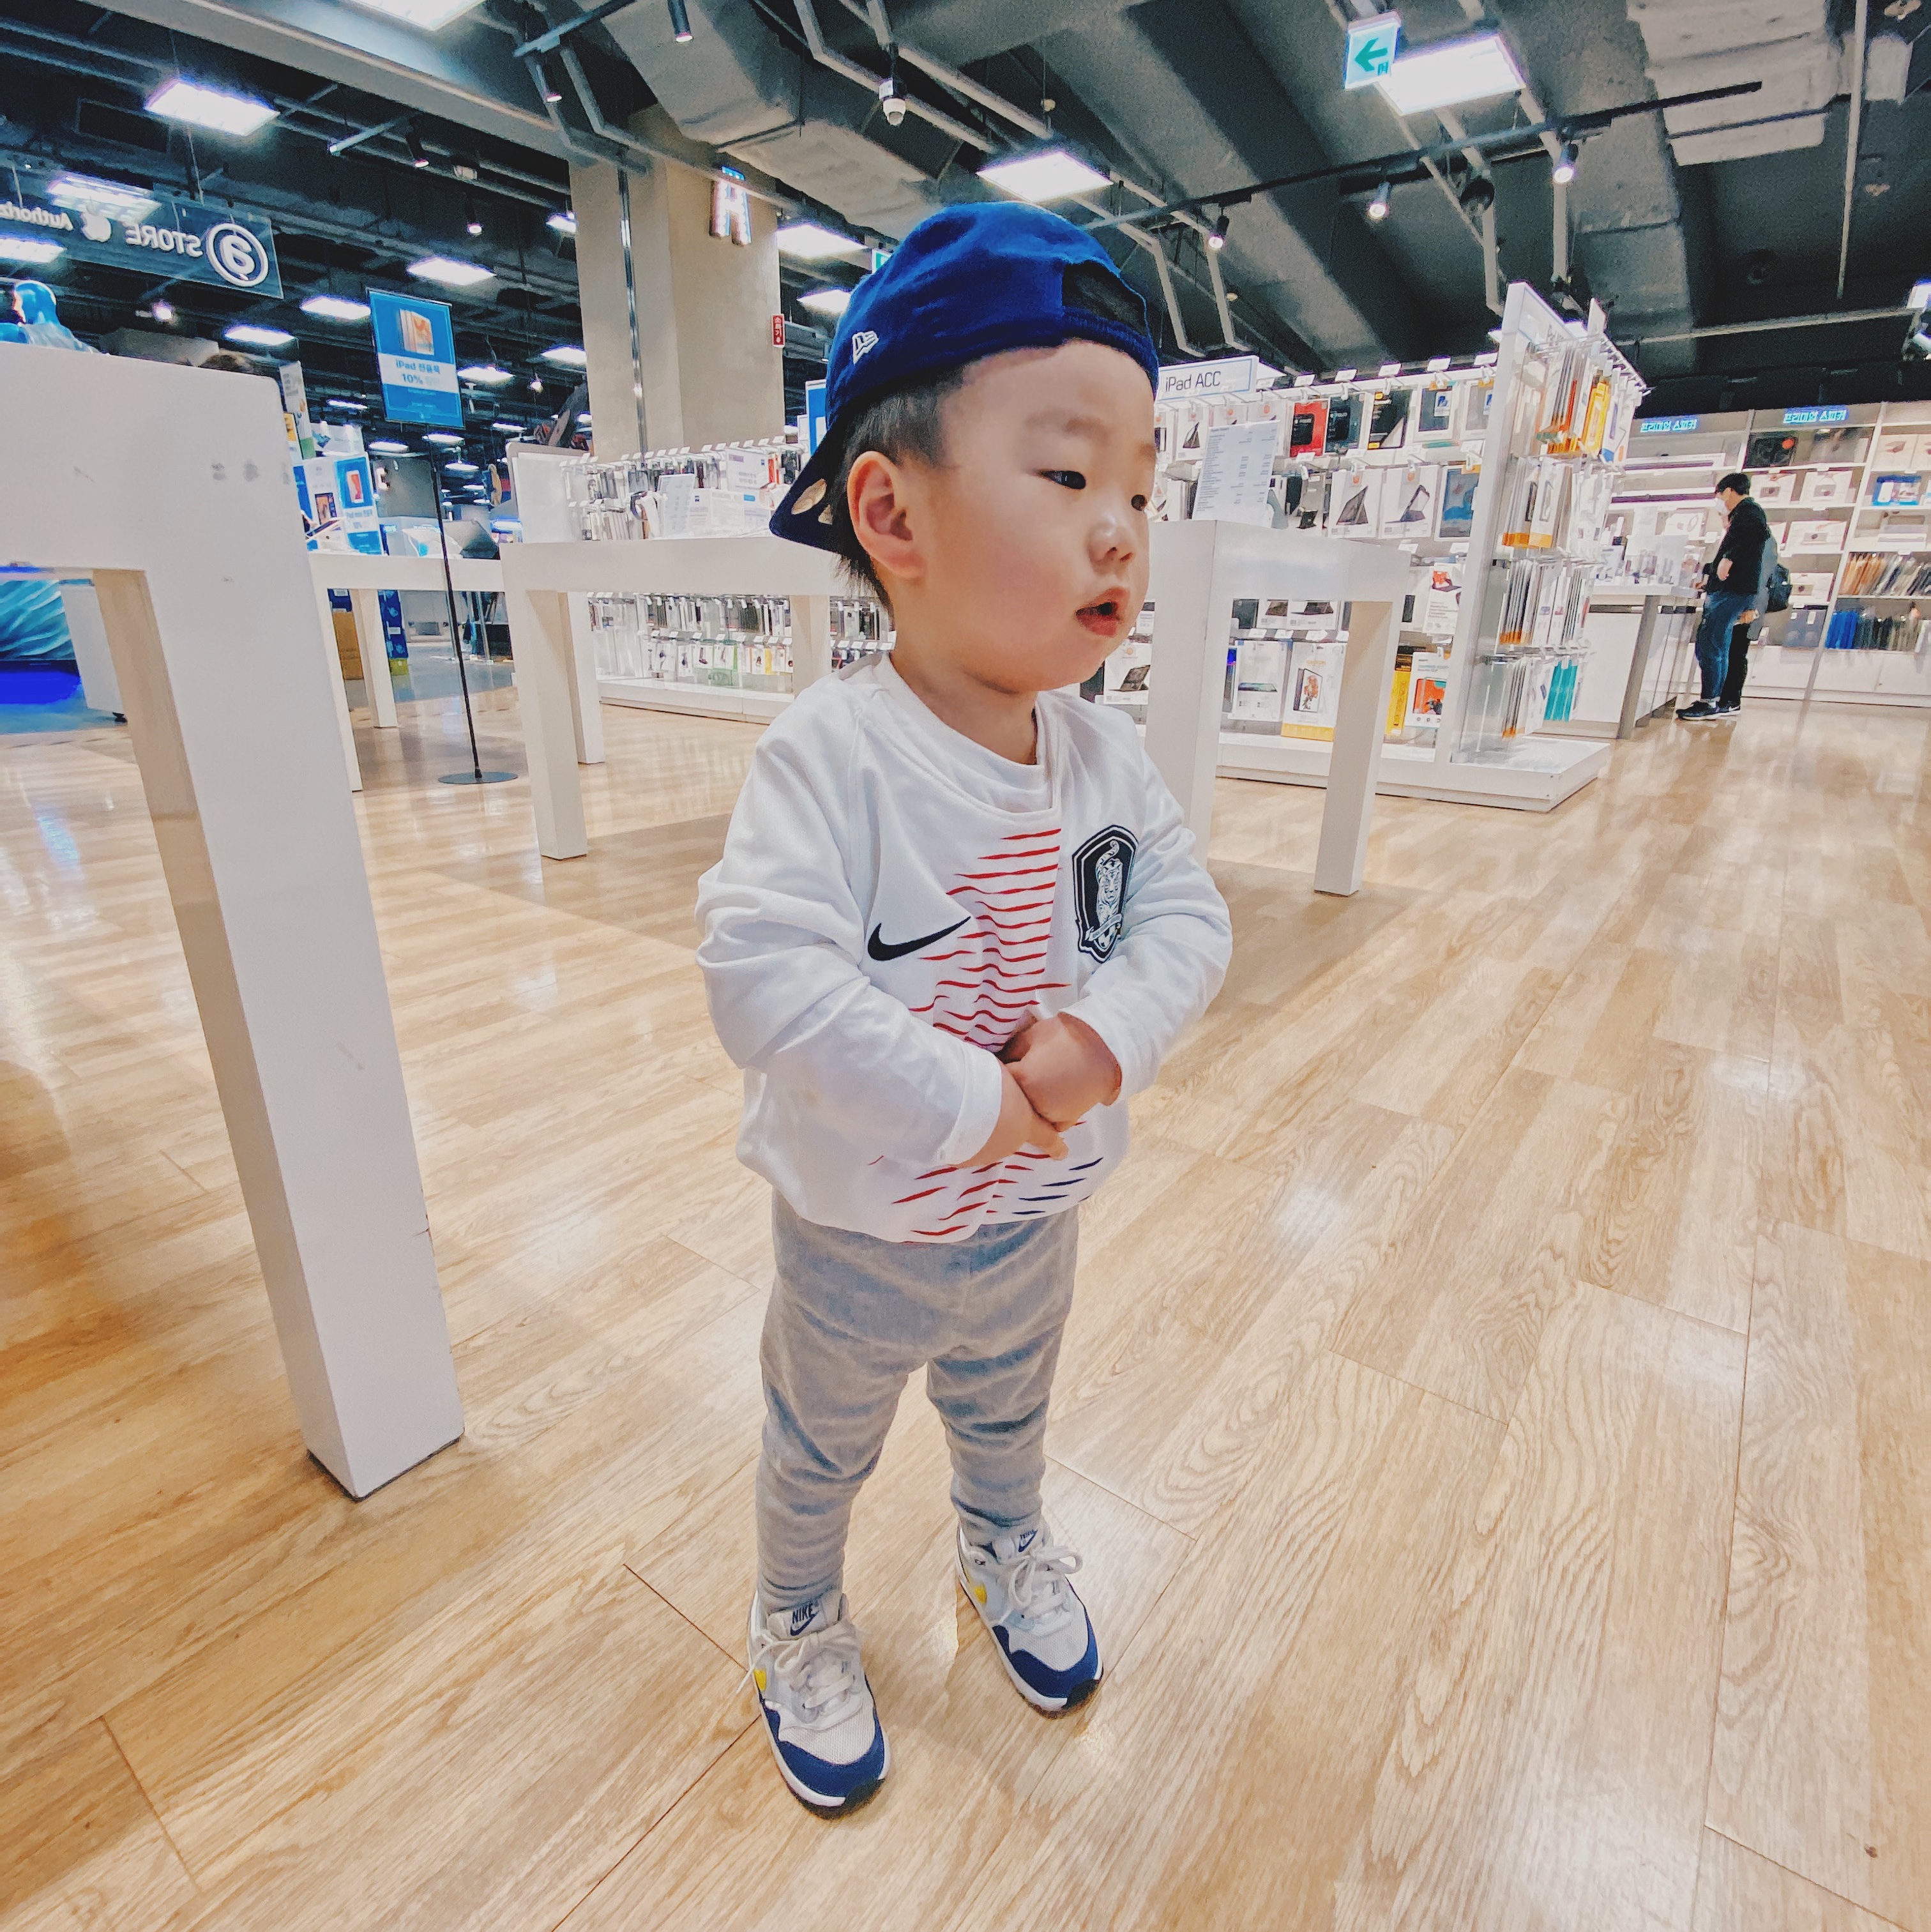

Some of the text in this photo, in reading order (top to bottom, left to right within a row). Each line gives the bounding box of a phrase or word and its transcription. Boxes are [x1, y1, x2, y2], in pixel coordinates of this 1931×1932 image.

[396, 360, 416, 370] iPad
[402, 372, 423, 384] 10%
[1165, 370, 1222, 392] iPad ACC
[1783, 411, 1819, 424] 프리미엄
[792, 1602, 815, 1624] NIKE
